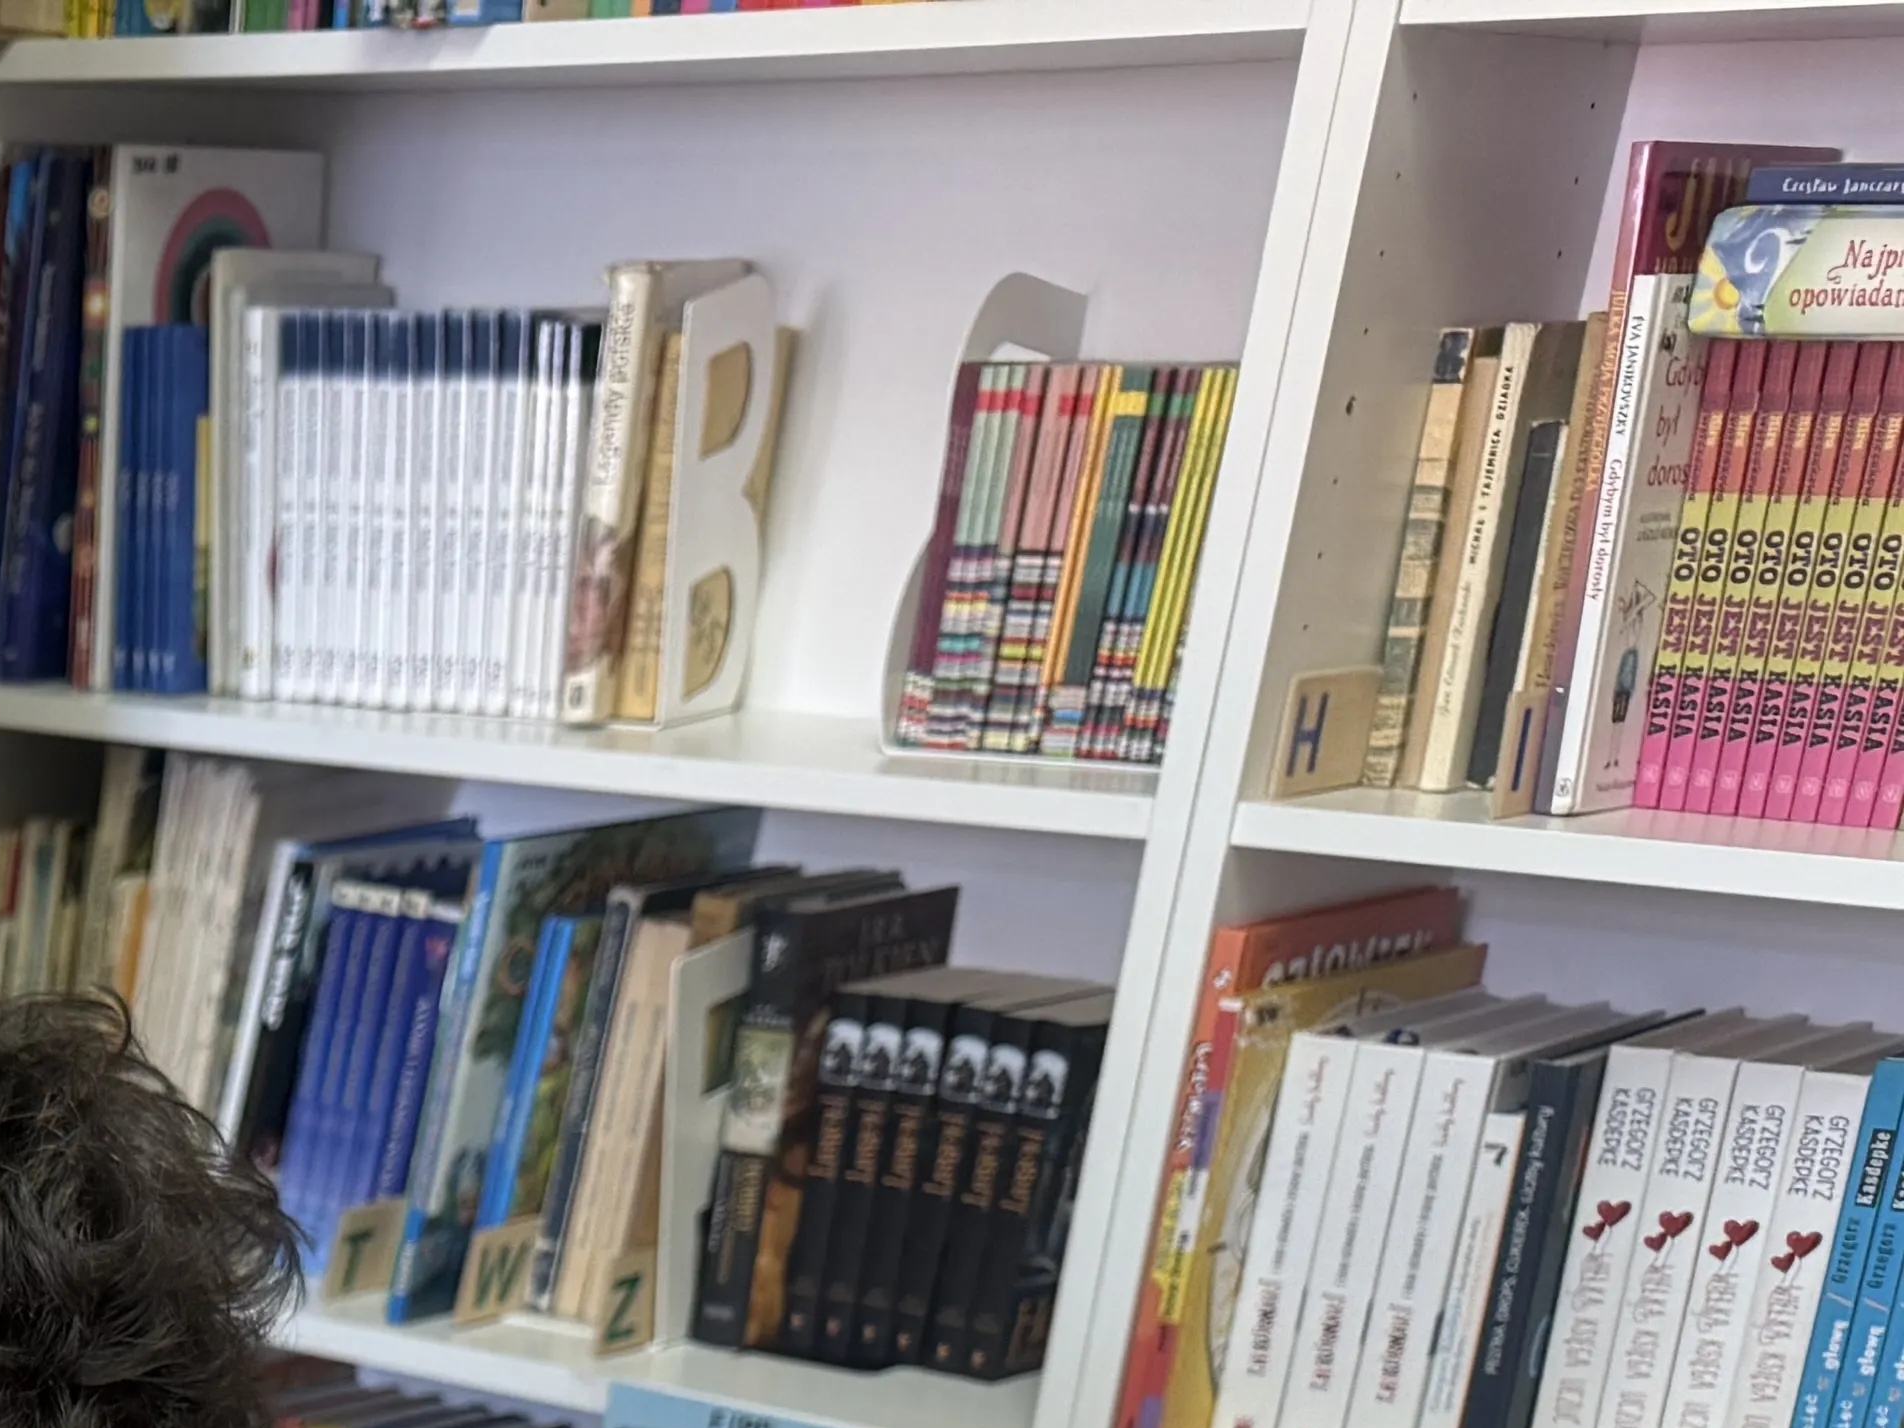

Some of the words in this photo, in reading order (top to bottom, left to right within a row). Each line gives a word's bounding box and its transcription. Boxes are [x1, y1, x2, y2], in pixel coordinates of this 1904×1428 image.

[1675, 528, 1701, 582] OTO
[1701, 528, 1727, 583] OTO
[1730, 529, 1757, 585] OTO
[1759, 530, 1785, 585] OTO
[1787, 531, 1813, 587] OTO
[1815, 532, 1842, 588] OTO
[1843, 533, 1872, 589] OTO
[1663, 593, 1689, 653] JEST
[1688, 594, 1717, 655] JEST
[1717, 595, 1744, 656] JEST
[1745, 596, 1772, 658] JEST
[1773, 597, 1801, 659] JEST
[1800, 598, 1829, 661] JEST
[1829, 600, 1859, 663] JEST
[1648, 664, 1676, 735] KASIA
[1674, 666, 1703, 738] KASIA
[1701, 668, 1731, 740] KASIA
[1728, 669, 1758, 742] KASIA
[1755, 671, 1787, 743] KASIA
[1782, 673, 1814, 746] KASIA
[1809, 674, 1842, 748] KASIA
[1286, 692, 1329, 777] H
[342, 1230, 374, 1293] T
[476, 1241, 531, 1309] W
[602, 1273, 644, 1343] Z
